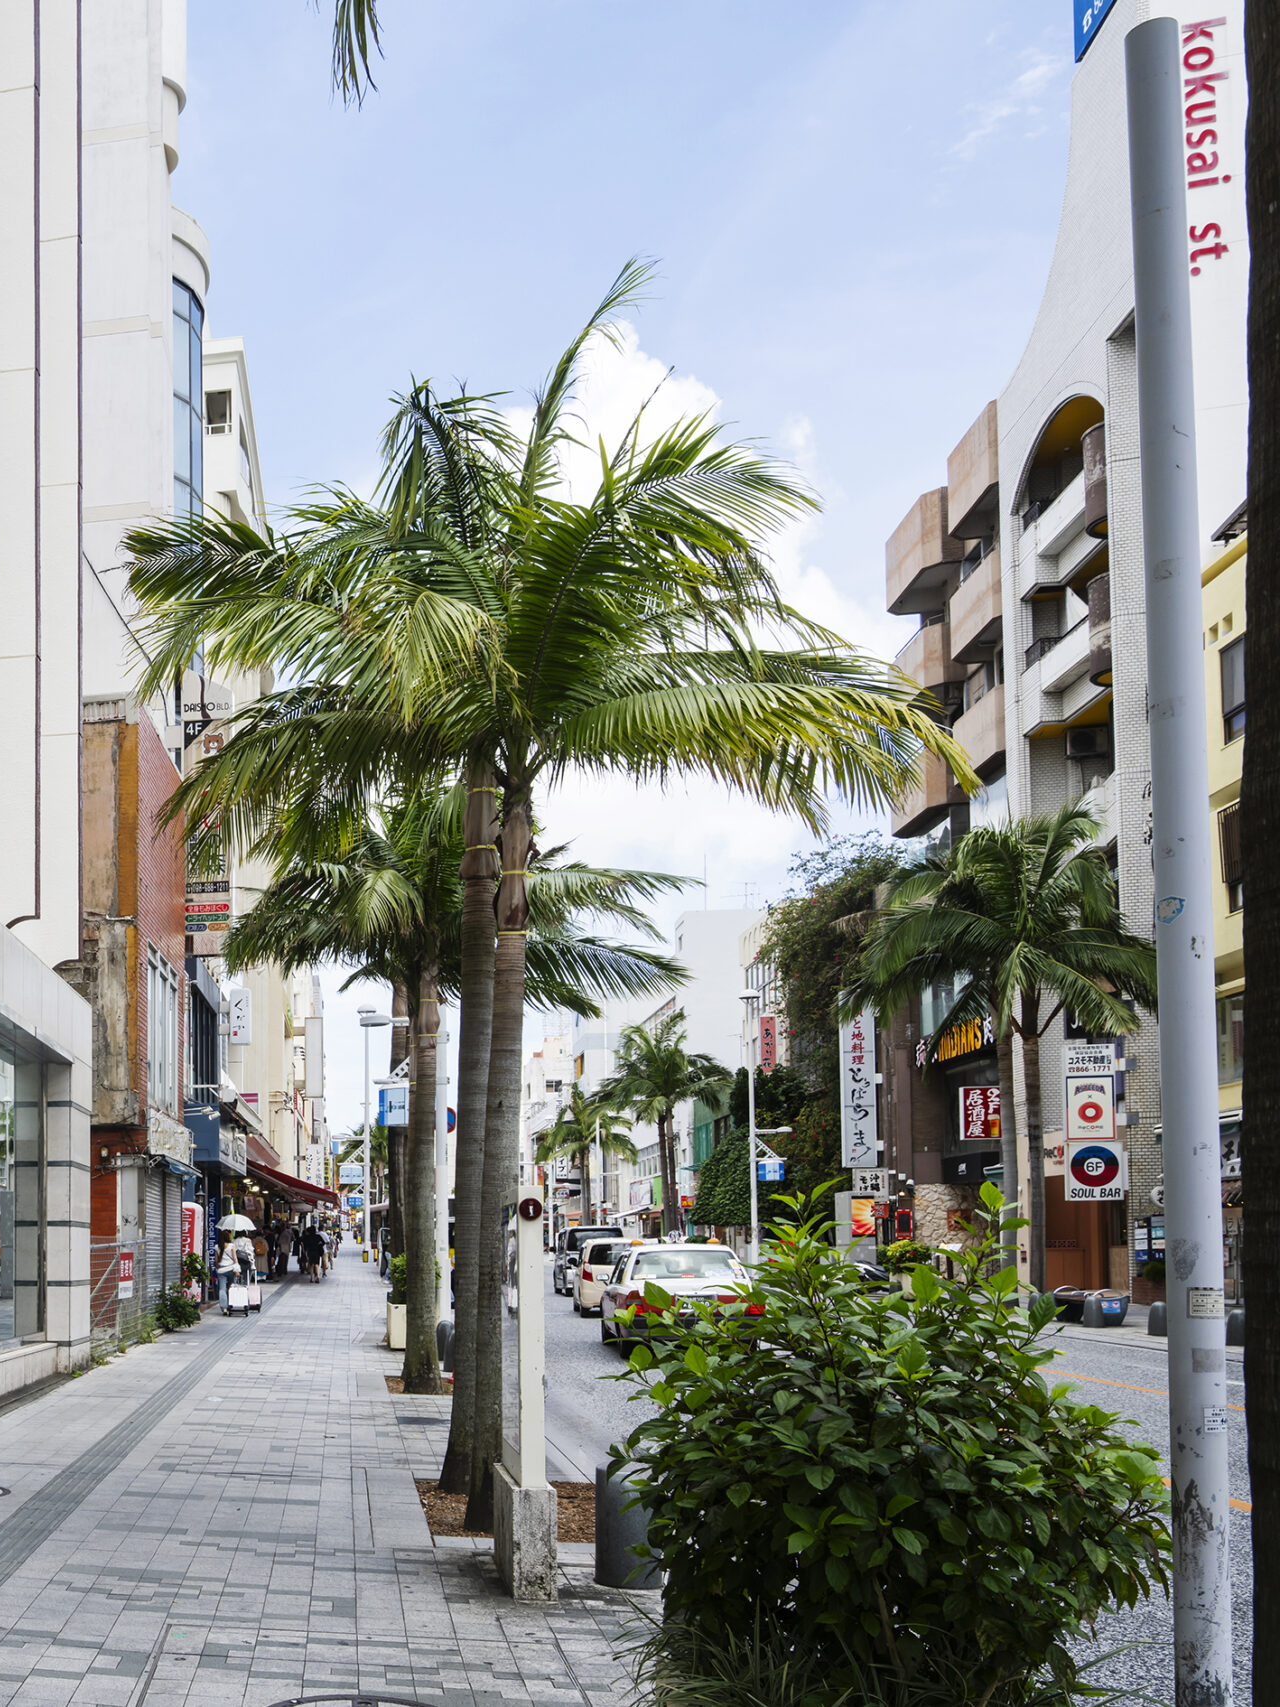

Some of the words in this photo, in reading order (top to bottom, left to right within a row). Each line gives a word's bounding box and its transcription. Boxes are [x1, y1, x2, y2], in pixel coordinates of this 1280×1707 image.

[1181, 16, 1231, 189] kokusai
[1189, 222, 1229, 277] st.
[186, 722, 202, 736] 4F
[1068, 1055, 1106, 1065] コスモ不動産
[1075, 1065, 1111, 1073] 866-1771
[966, 1089, 985, 1137] 居酒屋
[1086, 1161, 1103, 1172] 6F
[1071, 1188, 1096, 1199] SOUL
[1099, 1188, 1121, 1198] BAR
